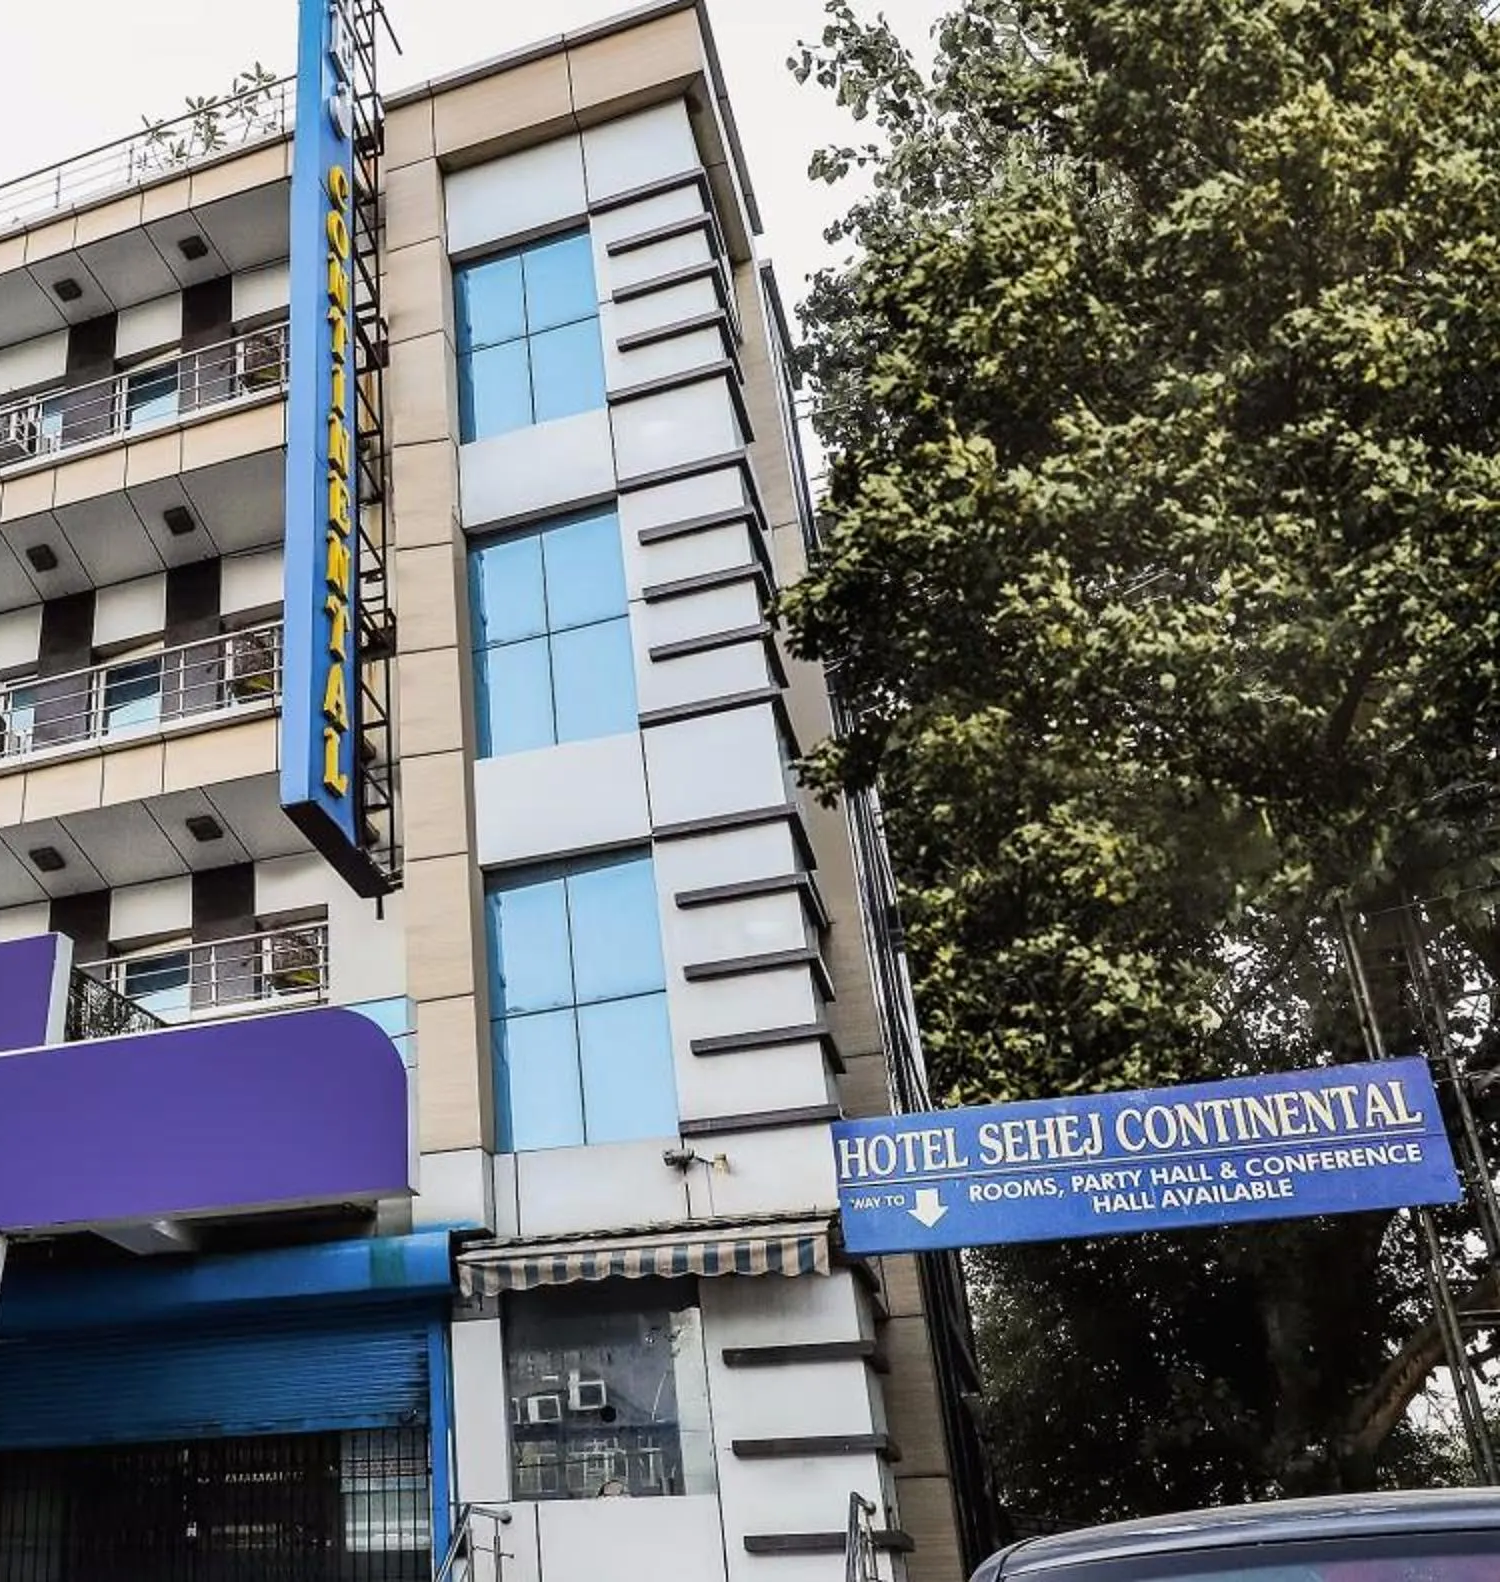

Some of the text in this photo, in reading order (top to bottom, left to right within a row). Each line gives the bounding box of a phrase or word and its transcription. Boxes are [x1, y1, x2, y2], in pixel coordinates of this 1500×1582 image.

[323, 165, 349, 798] CONTINENTAL
[837, 1081, 1423, 1180] HOTEL SEHEJ CONTINENTAL
[885, 1195, 905, 1206] TO
[969, 1143, 1423, 1203] ROOMS, PARTY HALL & CONFERENCE
[1092, 1180, 1294, 1214] HALL AVAILABLE
